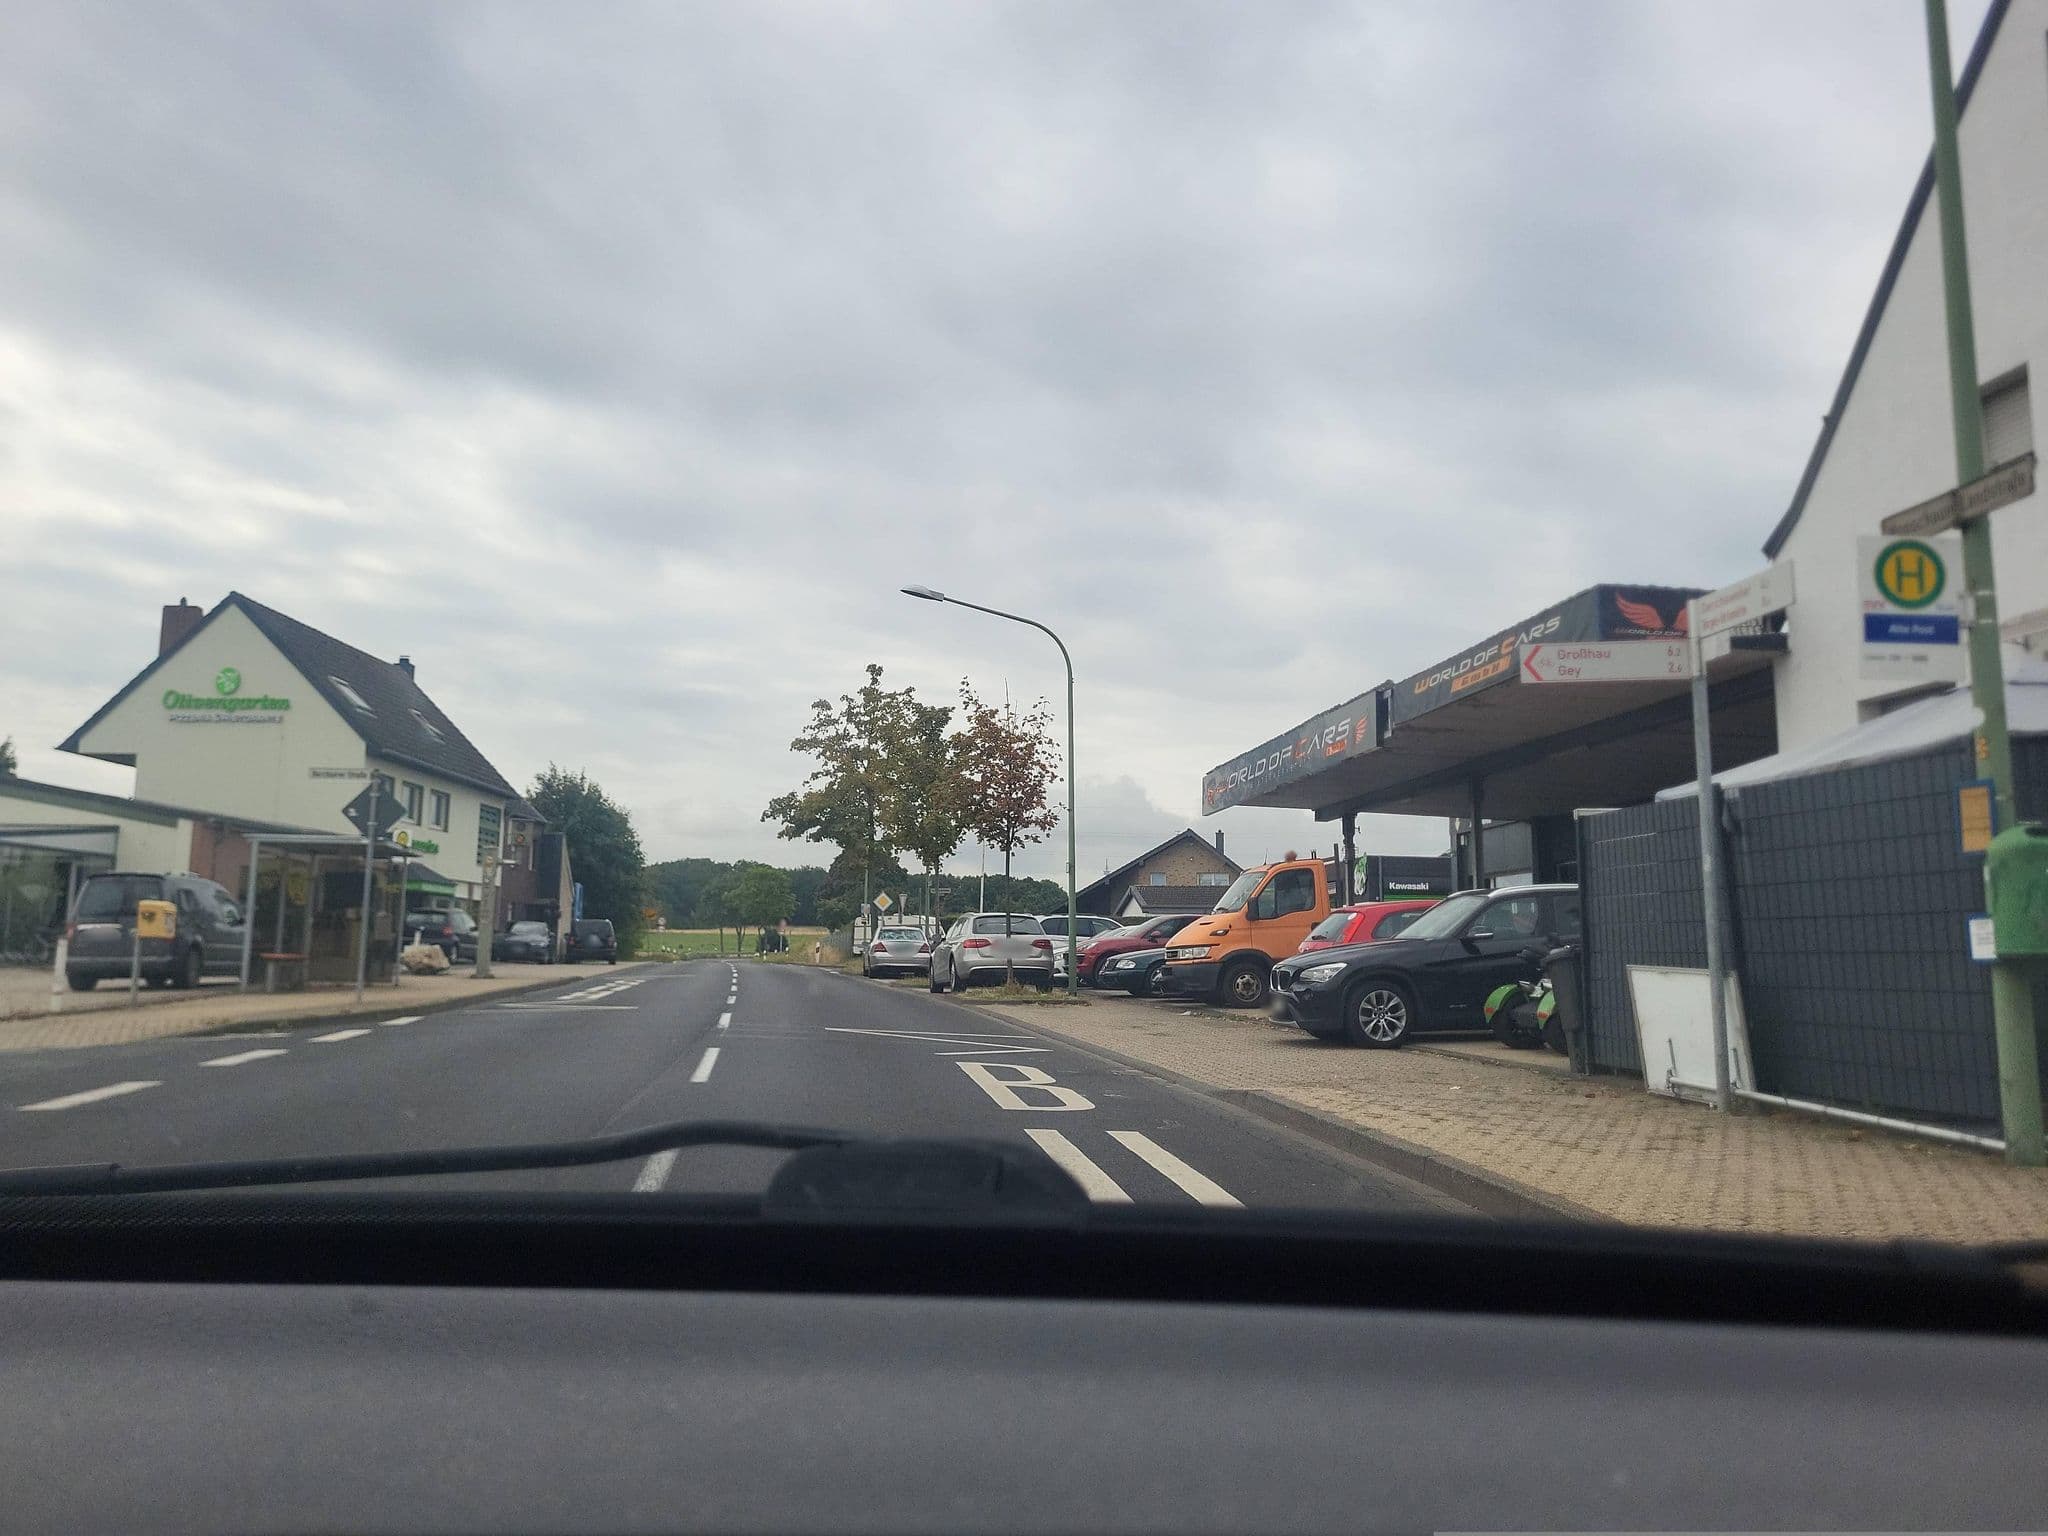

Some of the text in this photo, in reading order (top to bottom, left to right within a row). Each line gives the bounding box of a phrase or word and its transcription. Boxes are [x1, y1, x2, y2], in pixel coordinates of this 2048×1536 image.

[1895, 554, 1925, 593] H
[1414, 616, 1561, 695] WORLD OF CARS
[1557, 648, 1612, 660] Großhau
[1558, 666, 1581, 677] Gey
[1269, 746, 1293, 770] OF
[1294, 718, 1351, 758] CARS
[1389, 881, 1429, 890] Kawasaki
[955, 1062, 1096, 1112] B
